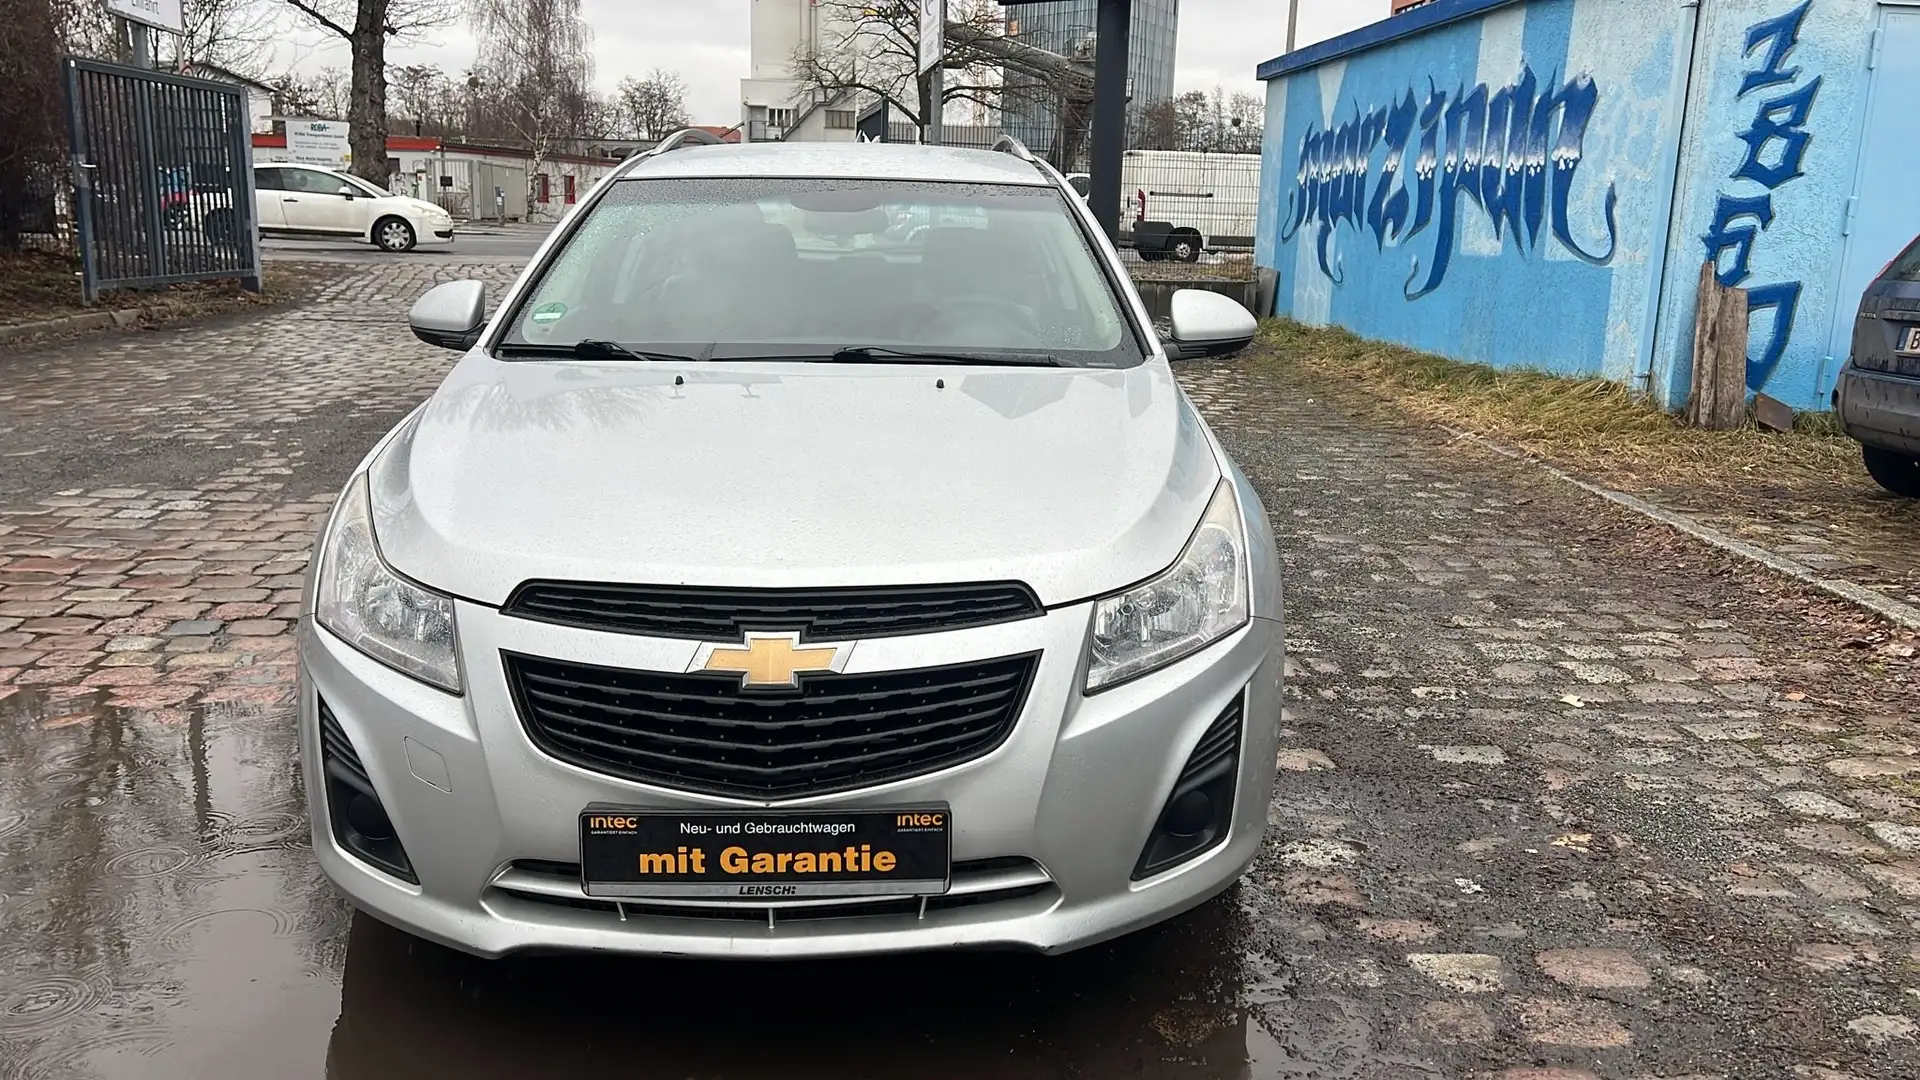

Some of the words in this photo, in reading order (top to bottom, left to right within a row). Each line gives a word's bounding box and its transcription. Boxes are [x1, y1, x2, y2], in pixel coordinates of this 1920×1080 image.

[680, 822, 712, 834] Neu-
[716, 822, 741, 834] und
[744, 822, 856, 835] Gebrauchtwagen
[639, 846, 706, 874] mit
[719, 844, 897, 874] Garantie
